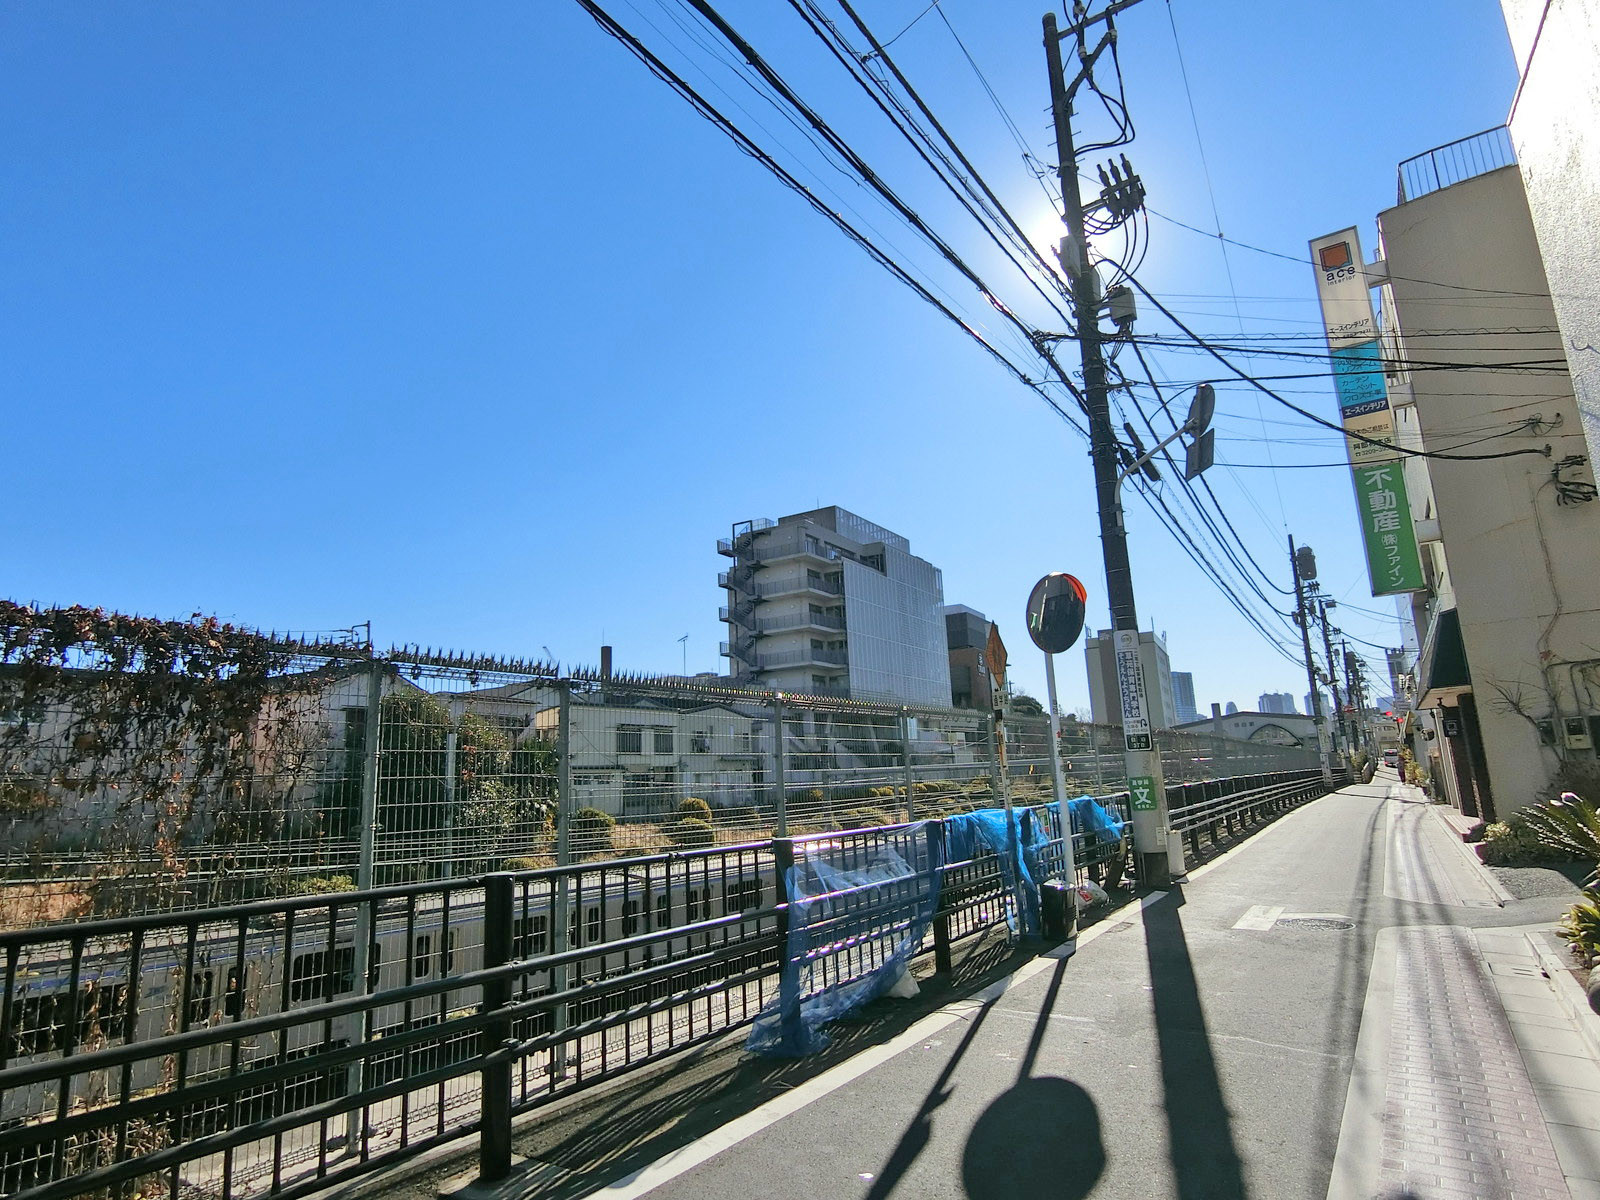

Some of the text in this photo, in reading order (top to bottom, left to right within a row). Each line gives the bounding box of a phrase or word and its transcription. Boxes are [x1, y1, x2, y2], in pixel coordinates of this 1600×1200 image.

[1326, 266, 1356, 281] ace
[1327, 274, 1356, 286] interior
[1329, 318, 1370, 334] エースインテリア
[1342, 376, 1370, 387] カーテン
[1345, 400, 1386, 416] エースインテリア
[1363, 467, 1402, 533] 不動産
[1133, 786, 1152, 805] 文
